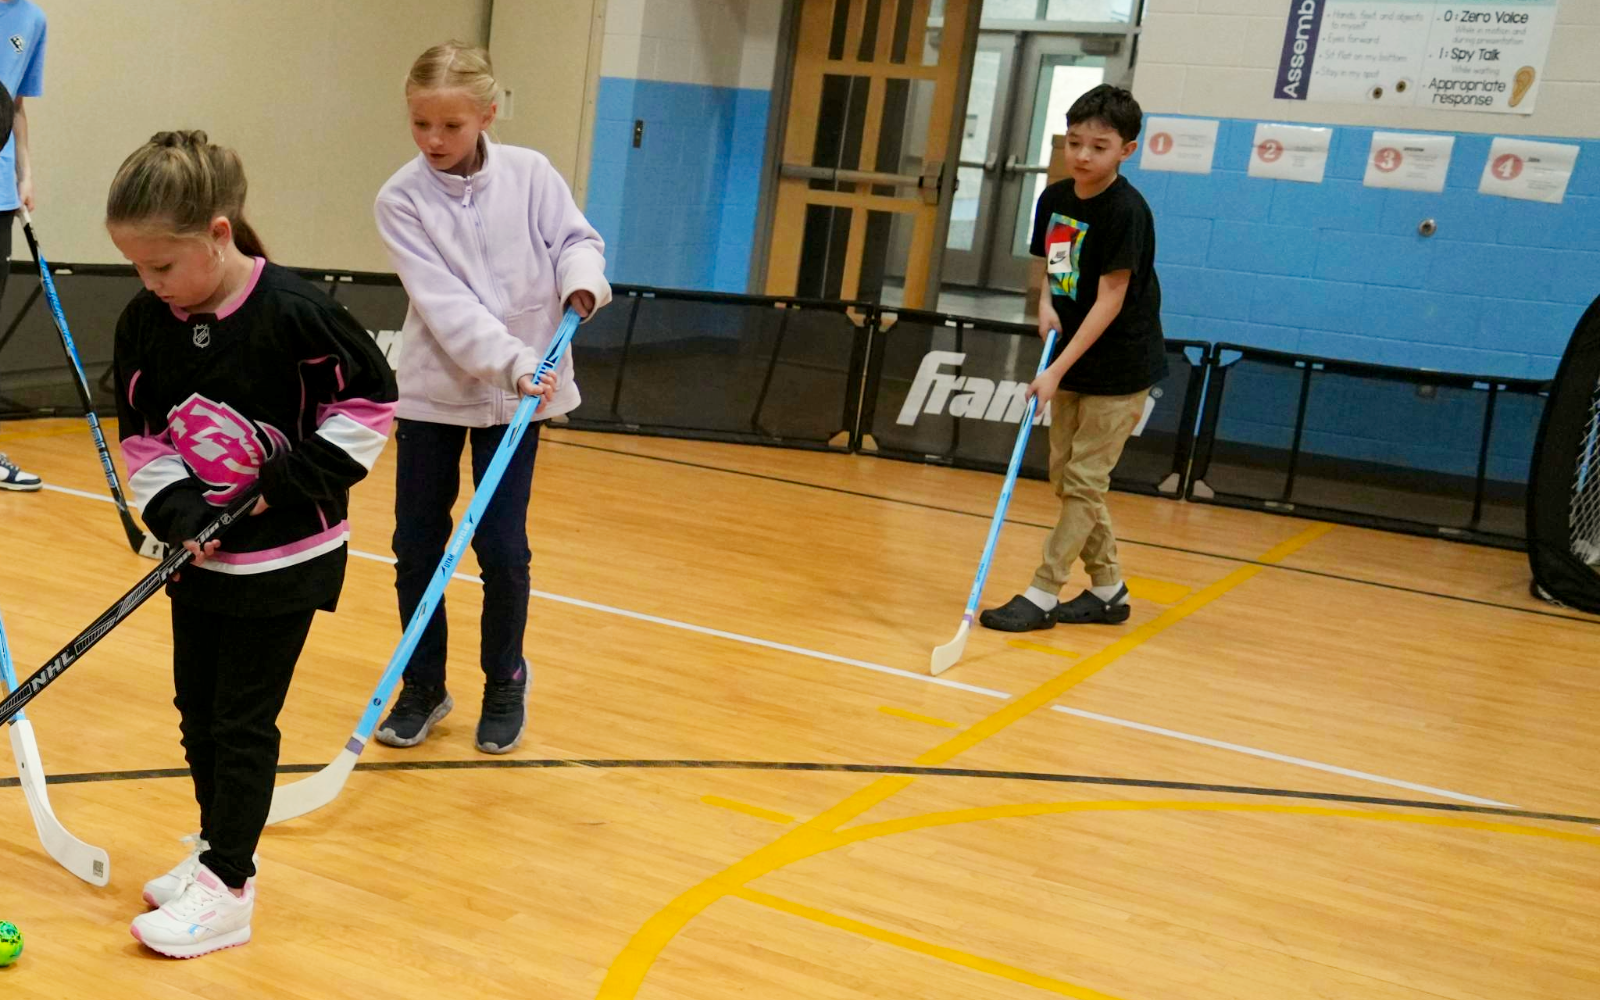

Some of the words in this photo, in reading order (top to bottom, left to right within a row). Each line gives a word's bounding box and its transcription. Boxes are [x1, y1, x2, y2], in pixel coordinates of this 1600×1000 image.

[1460, 10, 1491, 23] Zero
[1495, 11, 1529, 24] Voice
[1450, 47, 1475, 62] Spy
[1479, 48, 1500, 61] Talk
[1428, 77, 1506, 93] Appropriate
[1432, 93, 1493, 107] response
[1263, 142, 1277, 158] 2
[1382, 150, 1395, 169] 3
[1498, 157, 1513, 177] 4
[32, 648, 75, 692] NHL
